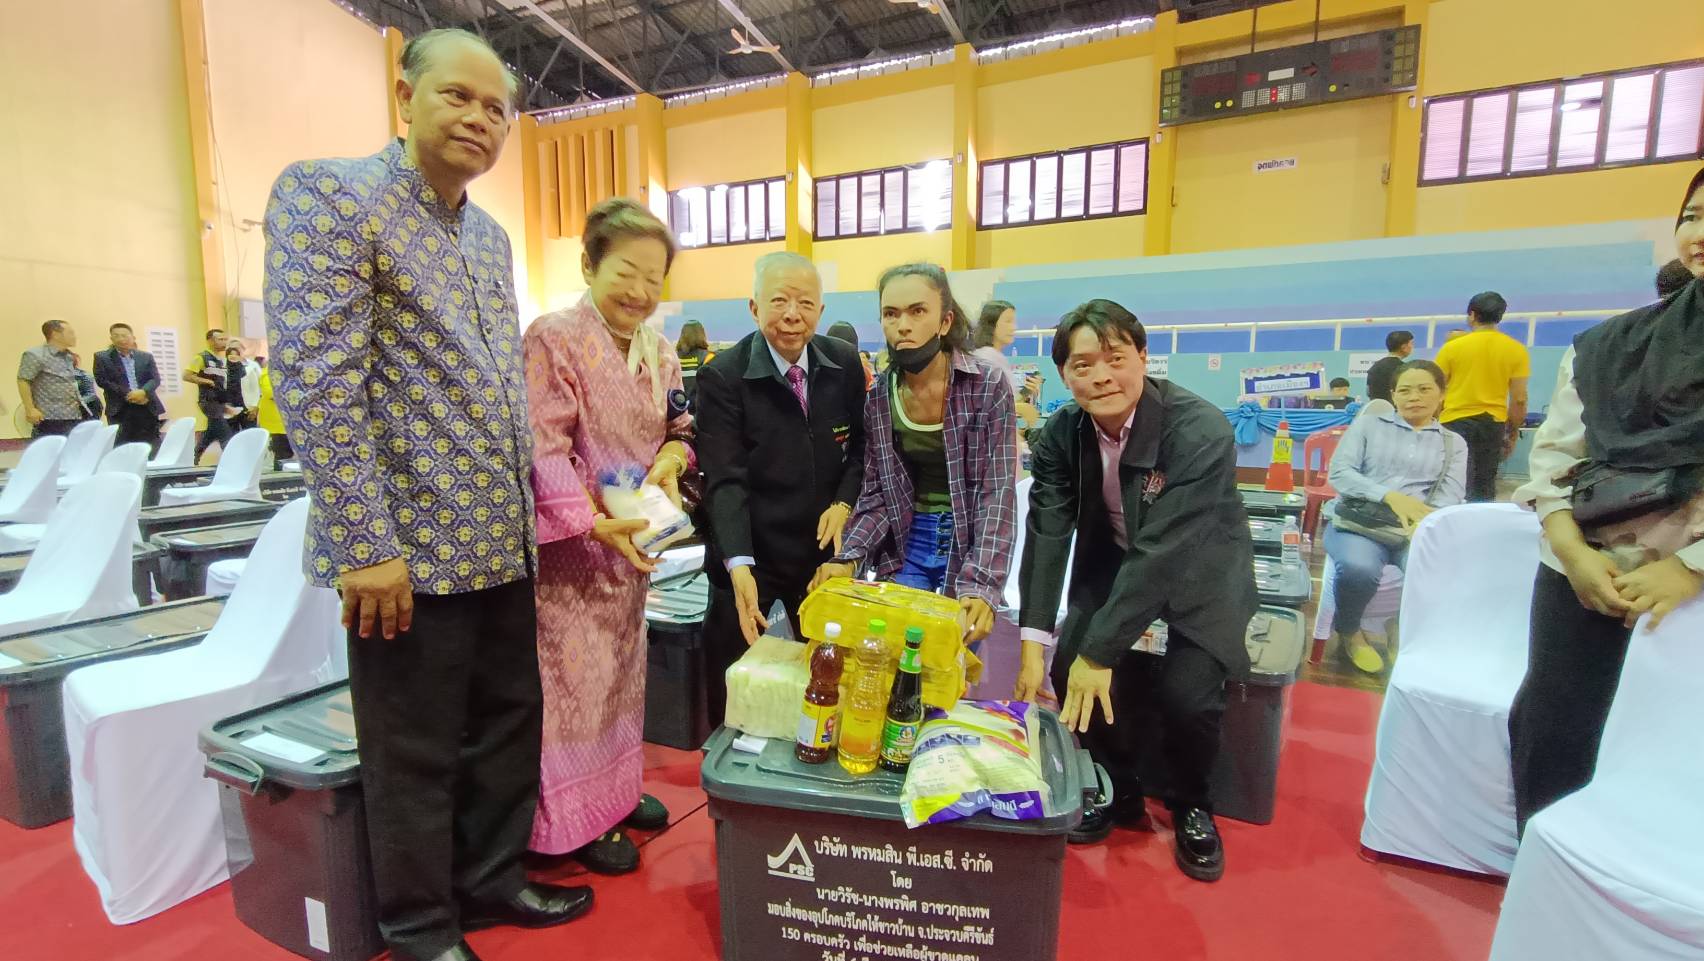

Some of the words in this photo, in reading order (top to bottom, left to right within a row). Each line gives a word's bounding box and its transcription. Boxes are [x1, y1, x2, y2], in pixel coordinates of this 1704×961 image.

[814, 835, 848, 858] บริษัท
[851, 843, 903, 865] พรหมสิน
[905, 845, 957, 870] พี.เอส.ซี.
[961, 851, 993, 873] จำกัด
[789, 862, 815, 877] PSC
[890, 870, 913, 889] โดย
[781, 926, 801, 941] 150
[803, 932, 851, 950] ครอบครัว
